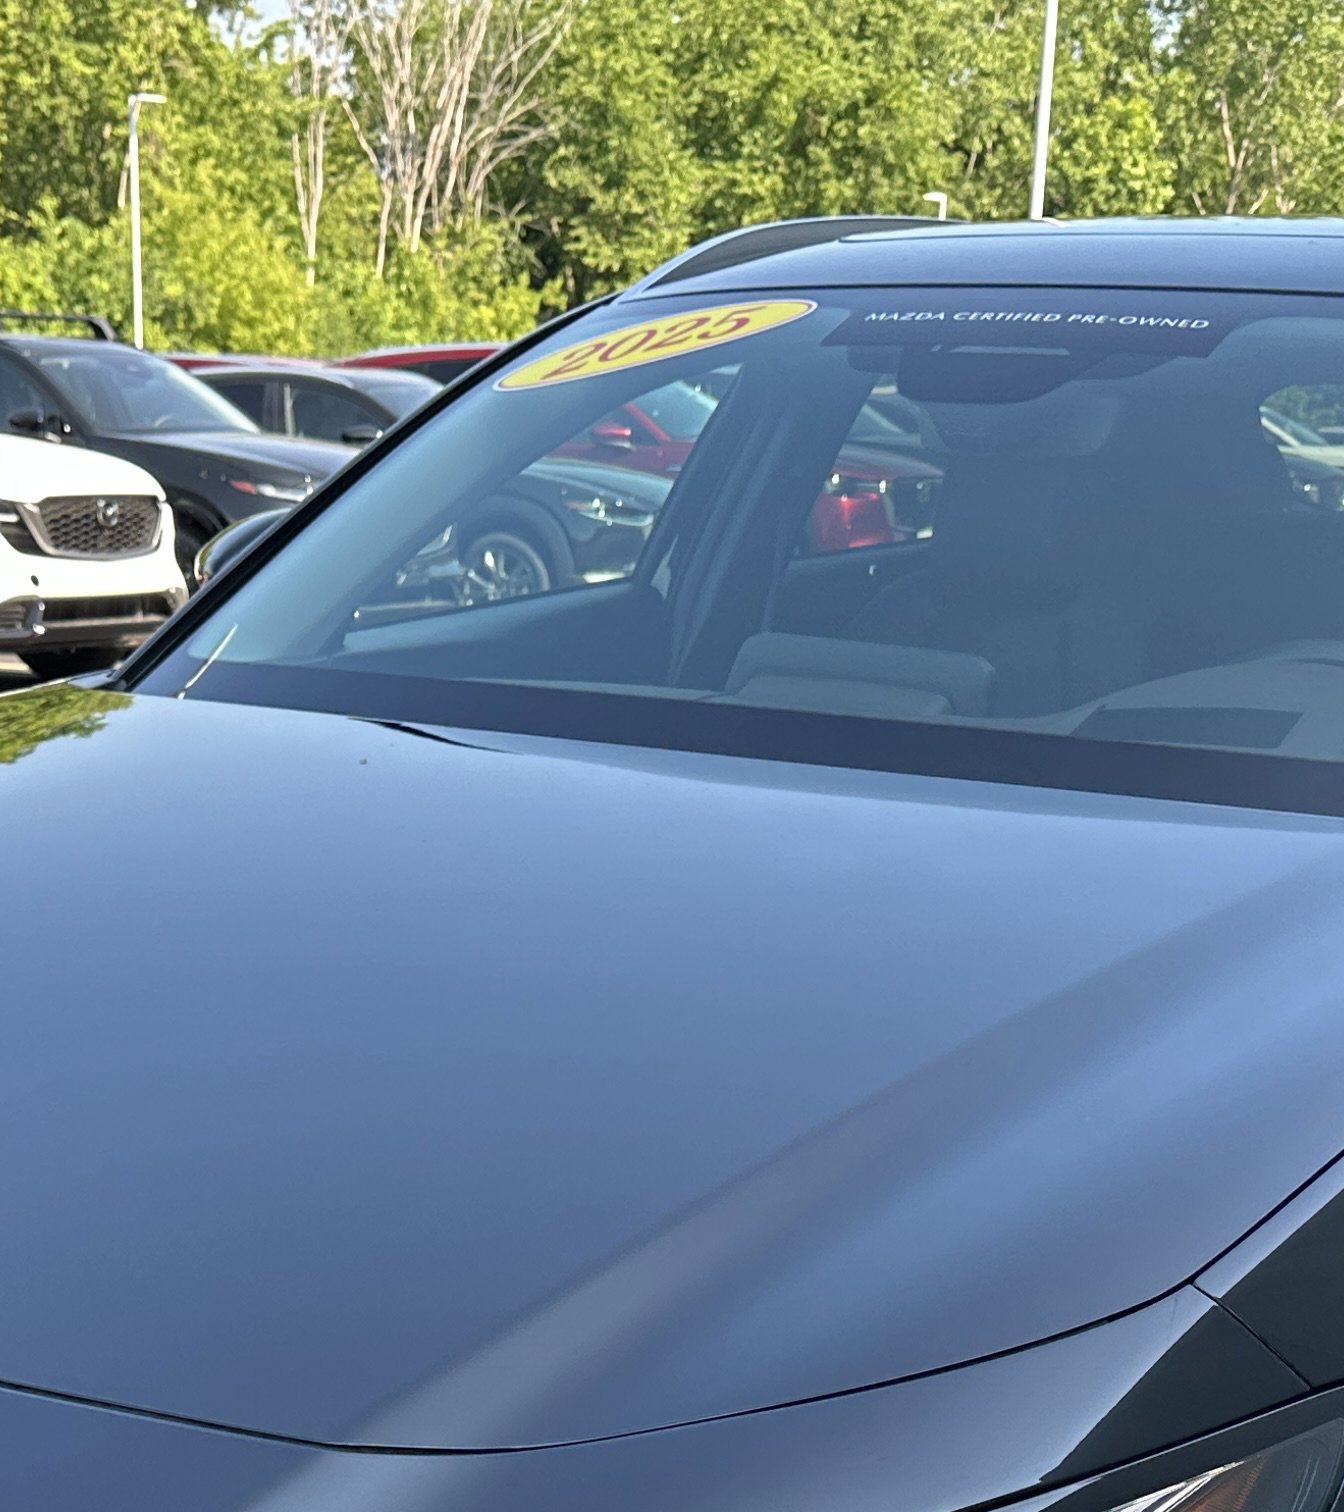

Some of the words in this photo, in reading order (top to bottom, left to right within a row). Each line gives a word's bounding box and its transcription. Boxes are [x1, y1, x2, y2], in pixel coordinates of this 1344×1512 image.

[541, 306, 766, 380] 2025
[864, 311, 945, 322] MAZDA
[952, 312, 1061, 323] CERTIFIED
[1067, 313, 1209, 329] PRE-OWNED
